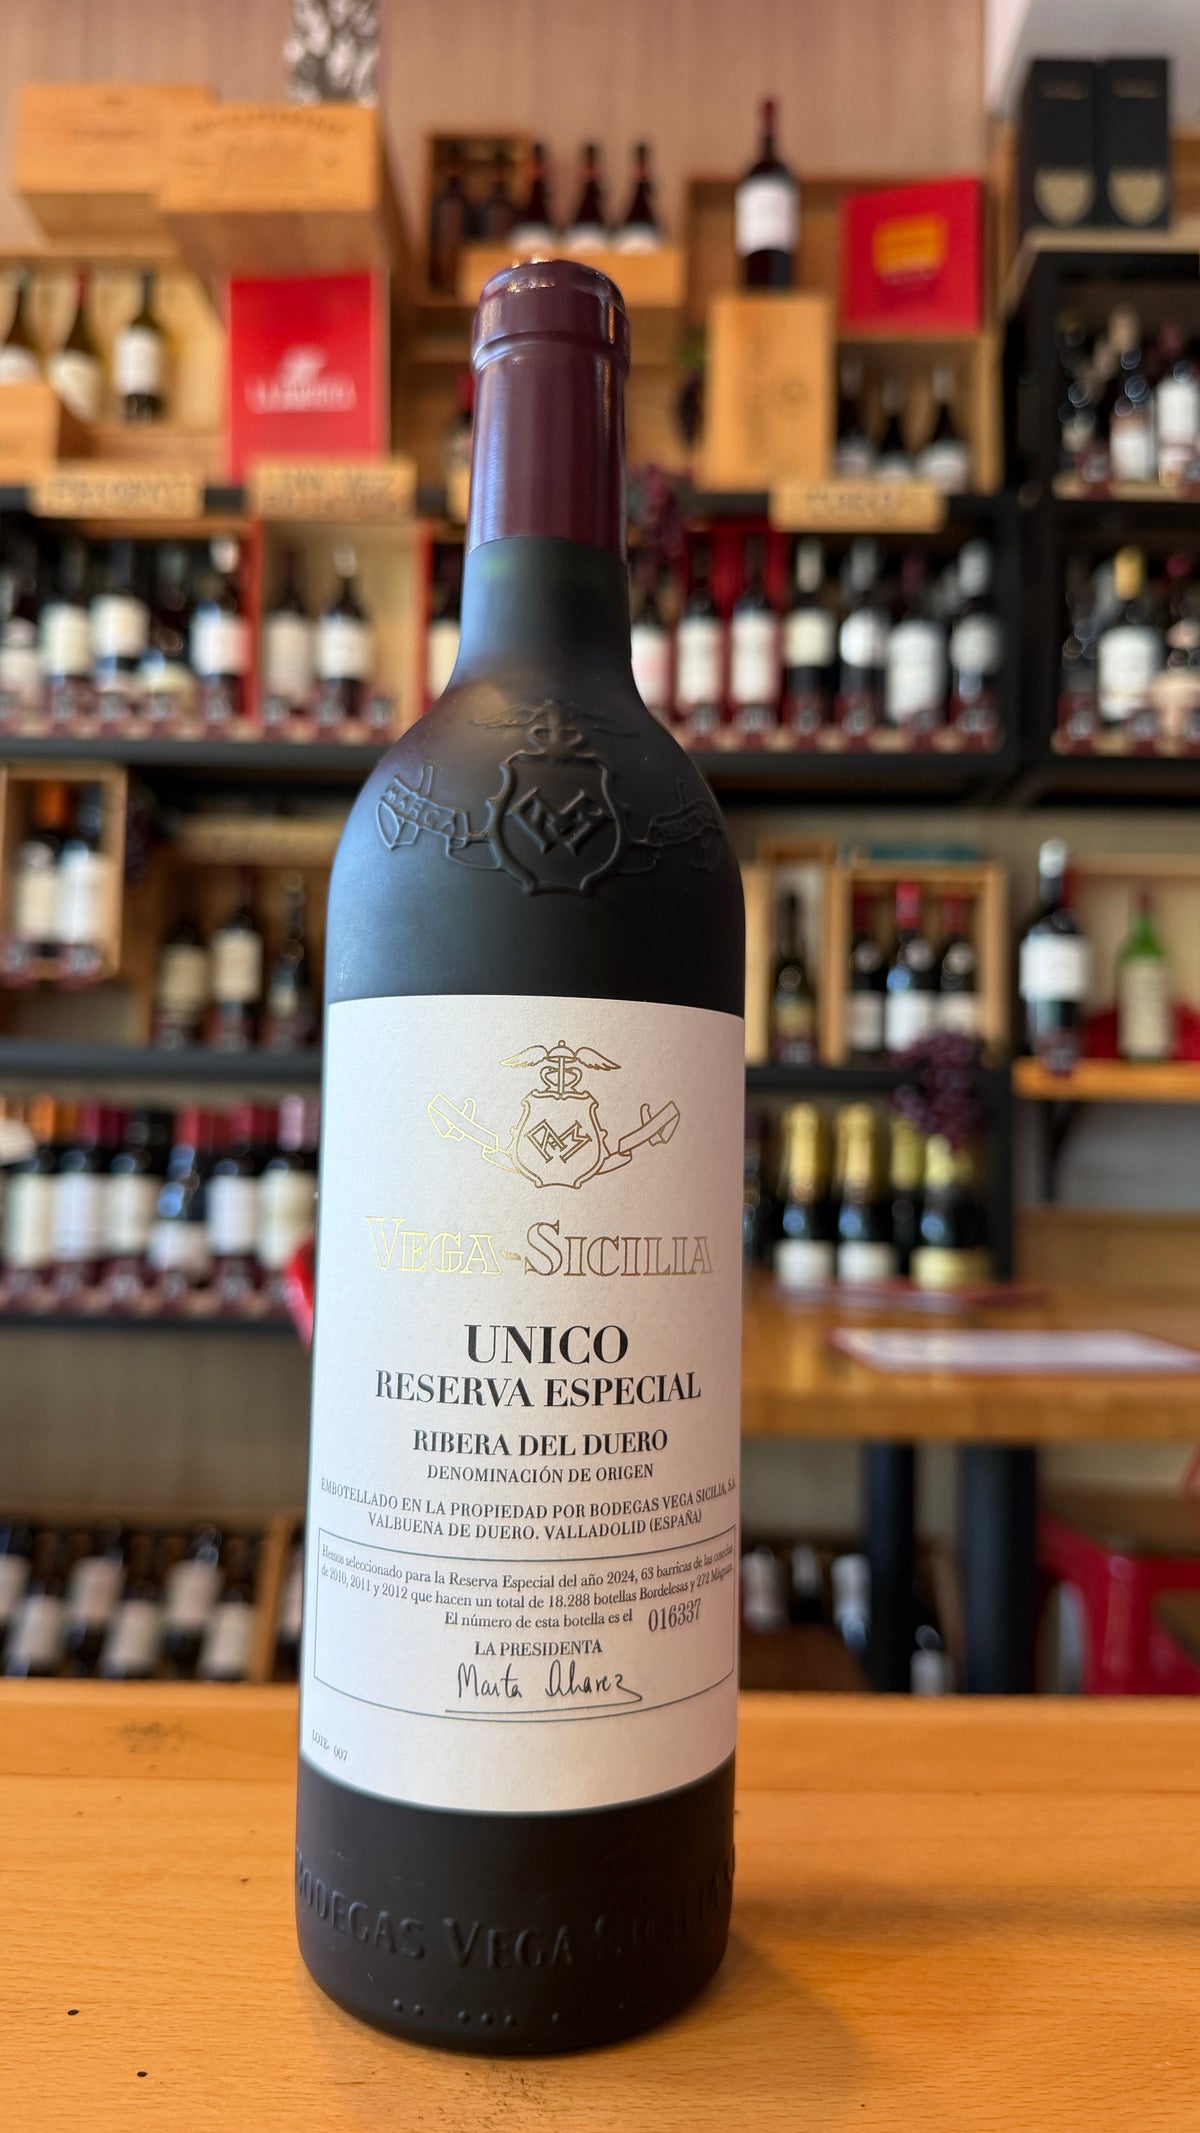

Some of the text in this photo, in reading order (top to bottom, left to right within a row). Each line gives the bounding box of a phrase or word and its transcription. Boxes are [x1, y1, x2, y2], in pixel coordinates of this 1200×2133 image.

[464, 1324, 629, 1364] UNICO
[375, 1370, 702, 1408] RESERVA ESPECIAL
[413, 1429, 668, 1456] RIBERA DEL DUERO
[427, 1464, 654, 1483] DENOMINACIÓN DE ORIGEN
[321, 1477, 398, 1509] EMBOTELLADO
[402, 1498, 422, 1513] EN
[426, 1500, 446, 1515] LA
[450, 1502, 547, 1519] PROPIEDAD
[552, 1504, 585, 1519] POR
[590, 1498, 659, 1517] BODEGAS
[663, 1491, 694, 1509] VEGA
[695, 1482, 727, 1504] SICILIA,
[368, 1508, 702, 1540] VALBUENA DE DUERO. VALLADOLID (ESPAÑA)
[321, 1564, 329, 1577] de
[329, 1567, 349, 1588] 2010,
[350, 1573, 371, 1592] 2011
[374, 1583, 380, 1598] y
[382, 1582, 408, 1600] 2012
[411, 1591, 432, 1606] que
[435, 1591, 472, 1607] hacen
[475, 1596, 493, 1608] un
[496, 1594, 525, 1608] total
[528, 1594, 544, 1608] de
[549, 1593, 590, 1608] 18.288
[593, 1589, 637, 1606] botellas
[639, 1580, 688, 1601] Bordelesas
[690, 1579, 696, 1593] y
[696, 1571, 710, 1588] 272
[322, 1544, 345, 1565] Hemos
[345, 1555, 403, 1579] seleccionado
[405, 1569, 431, 1584] para
[434, 1571, 446, 1585] la
[450, 1572, 498, 1588] Reserva
[502, 1574, 554, 1592] Especial
[558, 1574, 577, 1588] del
[580, 1573, 604, 1587] año
[607, 1569, 638, 1584] 2024,
[640, 1566, 654, 1580] 63
[656, 1561, 692, 1578] barricas
[693, 1556, 703, 1569] de
[704, 1554, 713, 1566] las
[444, 1598, 702, 1632] El número de esta botella es el 016337
[474, 1639, 603, 1657] LA PRESIDENTA
[457, 1662, 523, 1698] Marta
[333, 1745, 348, 1761] 007
[443, 1917, 575, 1969] VEGA
